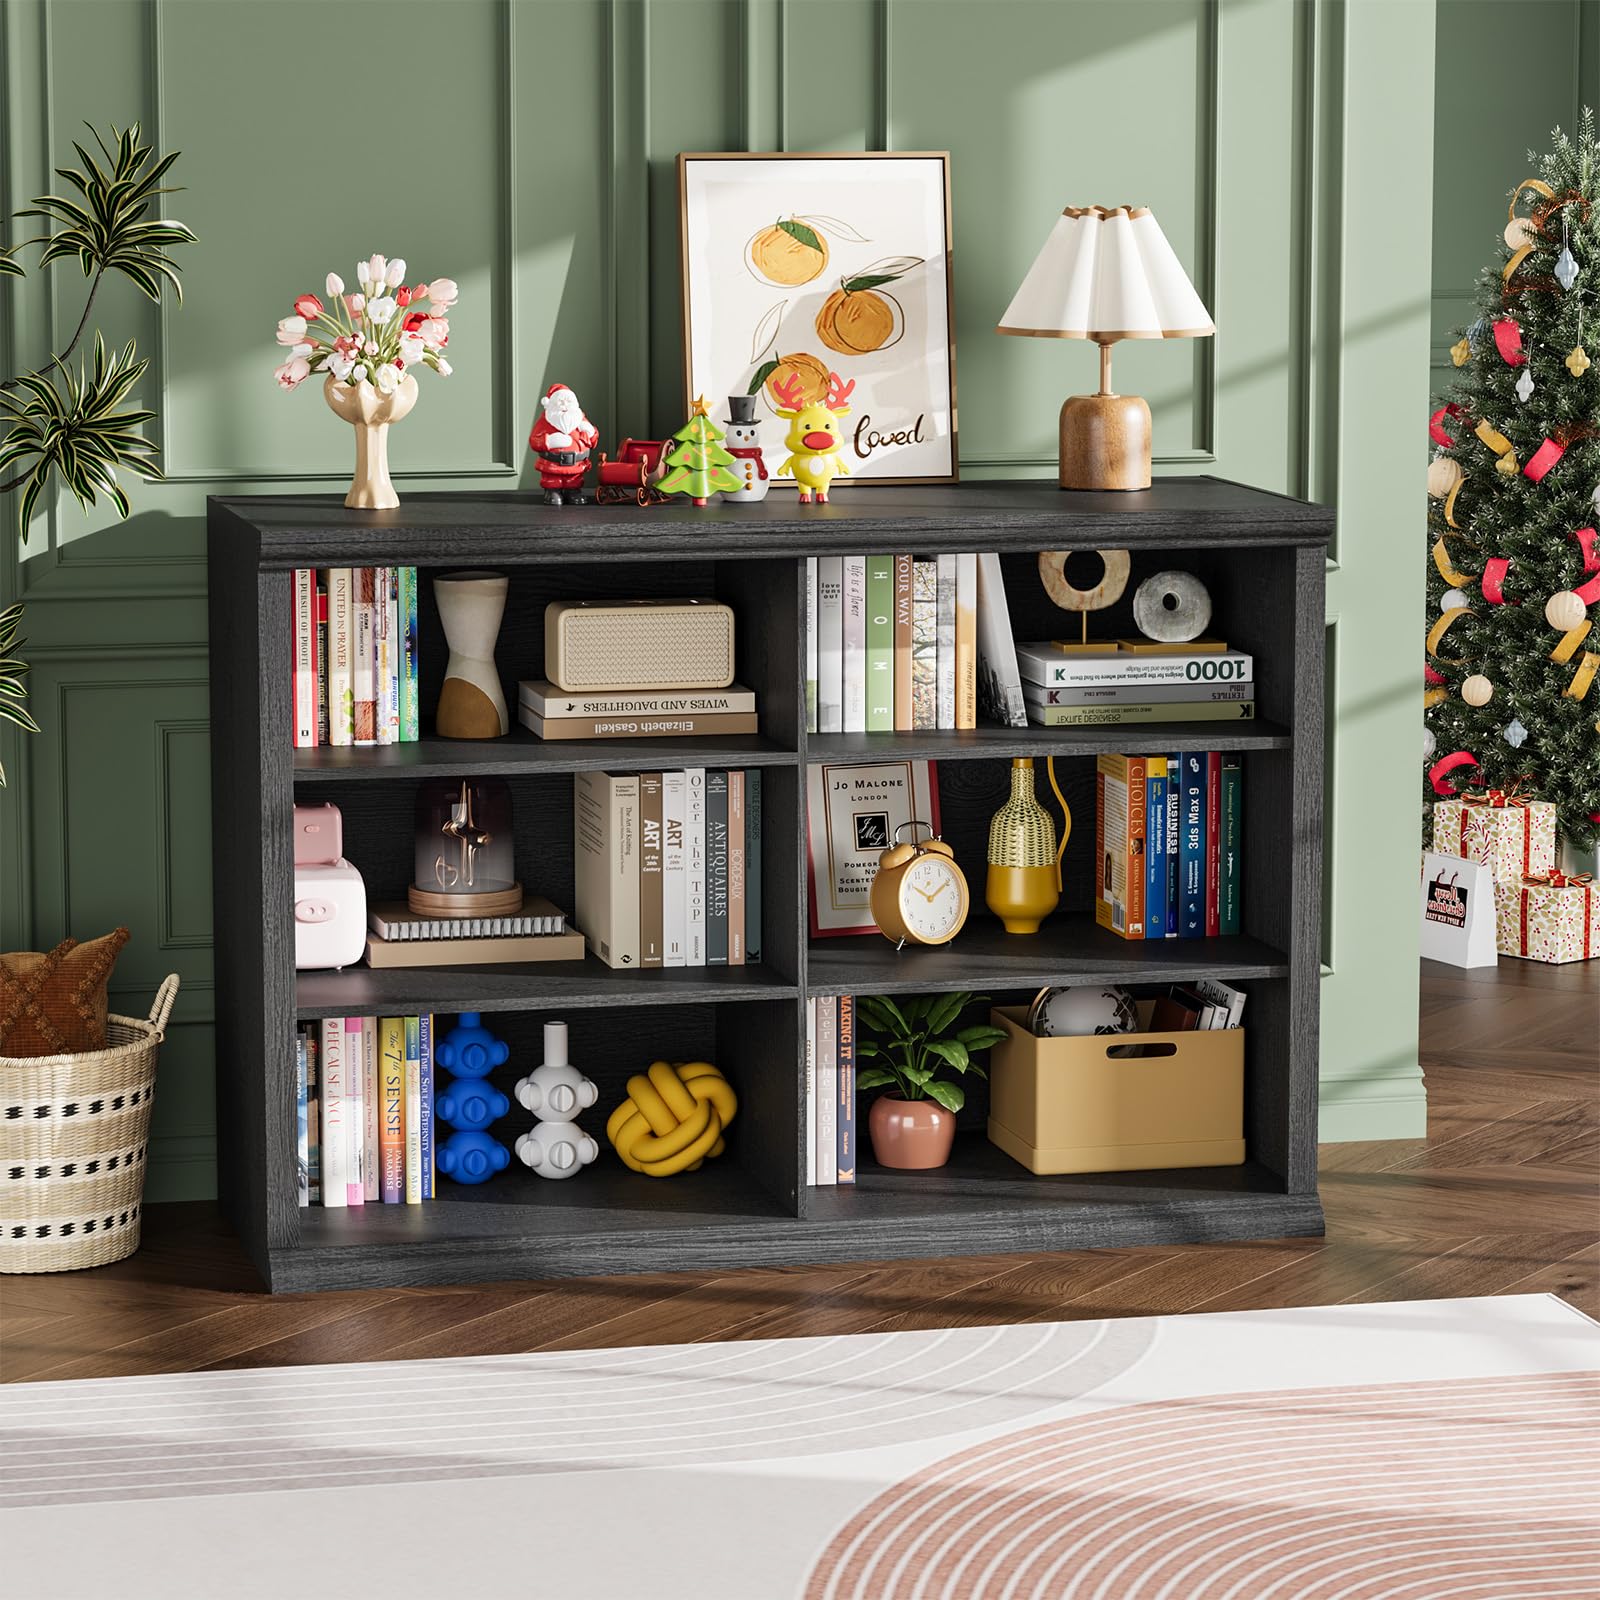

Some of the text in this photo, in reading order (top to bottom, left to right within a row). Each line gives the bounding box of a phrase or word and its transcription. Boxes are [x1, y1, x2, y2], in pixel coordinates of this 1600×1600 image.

[853, 414, 924, 459] loved
[300, 583, 308, 619] PURSUIT
[898, 554, 910, 626] YOUR WAY
[300, 622, 308, 633] OF
[337, 578, 347, 668] UNITED IN PRAYER
[300, 636, 309, 666] PROFIT
[1185, 660, 1246, 681] 1000
[583, 699, 729, 713] WIVES AND DAUGHTERS
[595, 721, 694, 734] Elizabeth Gaskell
[691, 776, 702, 821] Over
[851, 794, 889, 802] LONDON
[855, 779, 904, 789] MALONE
[1130, 766, 1144, 834] CHOICES
[1171, 793, 1179, 855] BUSINESS
[1188, 798, 1199, 824] Max
[644, 819, 660, 850] ART
[667, 819, 682, 849] ART
[1188, 828, 1199, 849] 3ds
[713, 821, 727, 918] ANTIQUAIRES
[731, 849, 742, 900] BORDEAUX
[691, 880, 702, 921] Top
[420, 1018, 430, 1042] BODY
[840, 995, 852, 1060] MAKING IT
[384, 1030, 403, 1136] The 7th SENSE
[421, 1077, 431, 1101] SOUL
[421, 1110, 431, 1152] ETERNITY
[386, 1148, 394, 1191] PARADISE
[395, 1177, 403, 1188] TO
